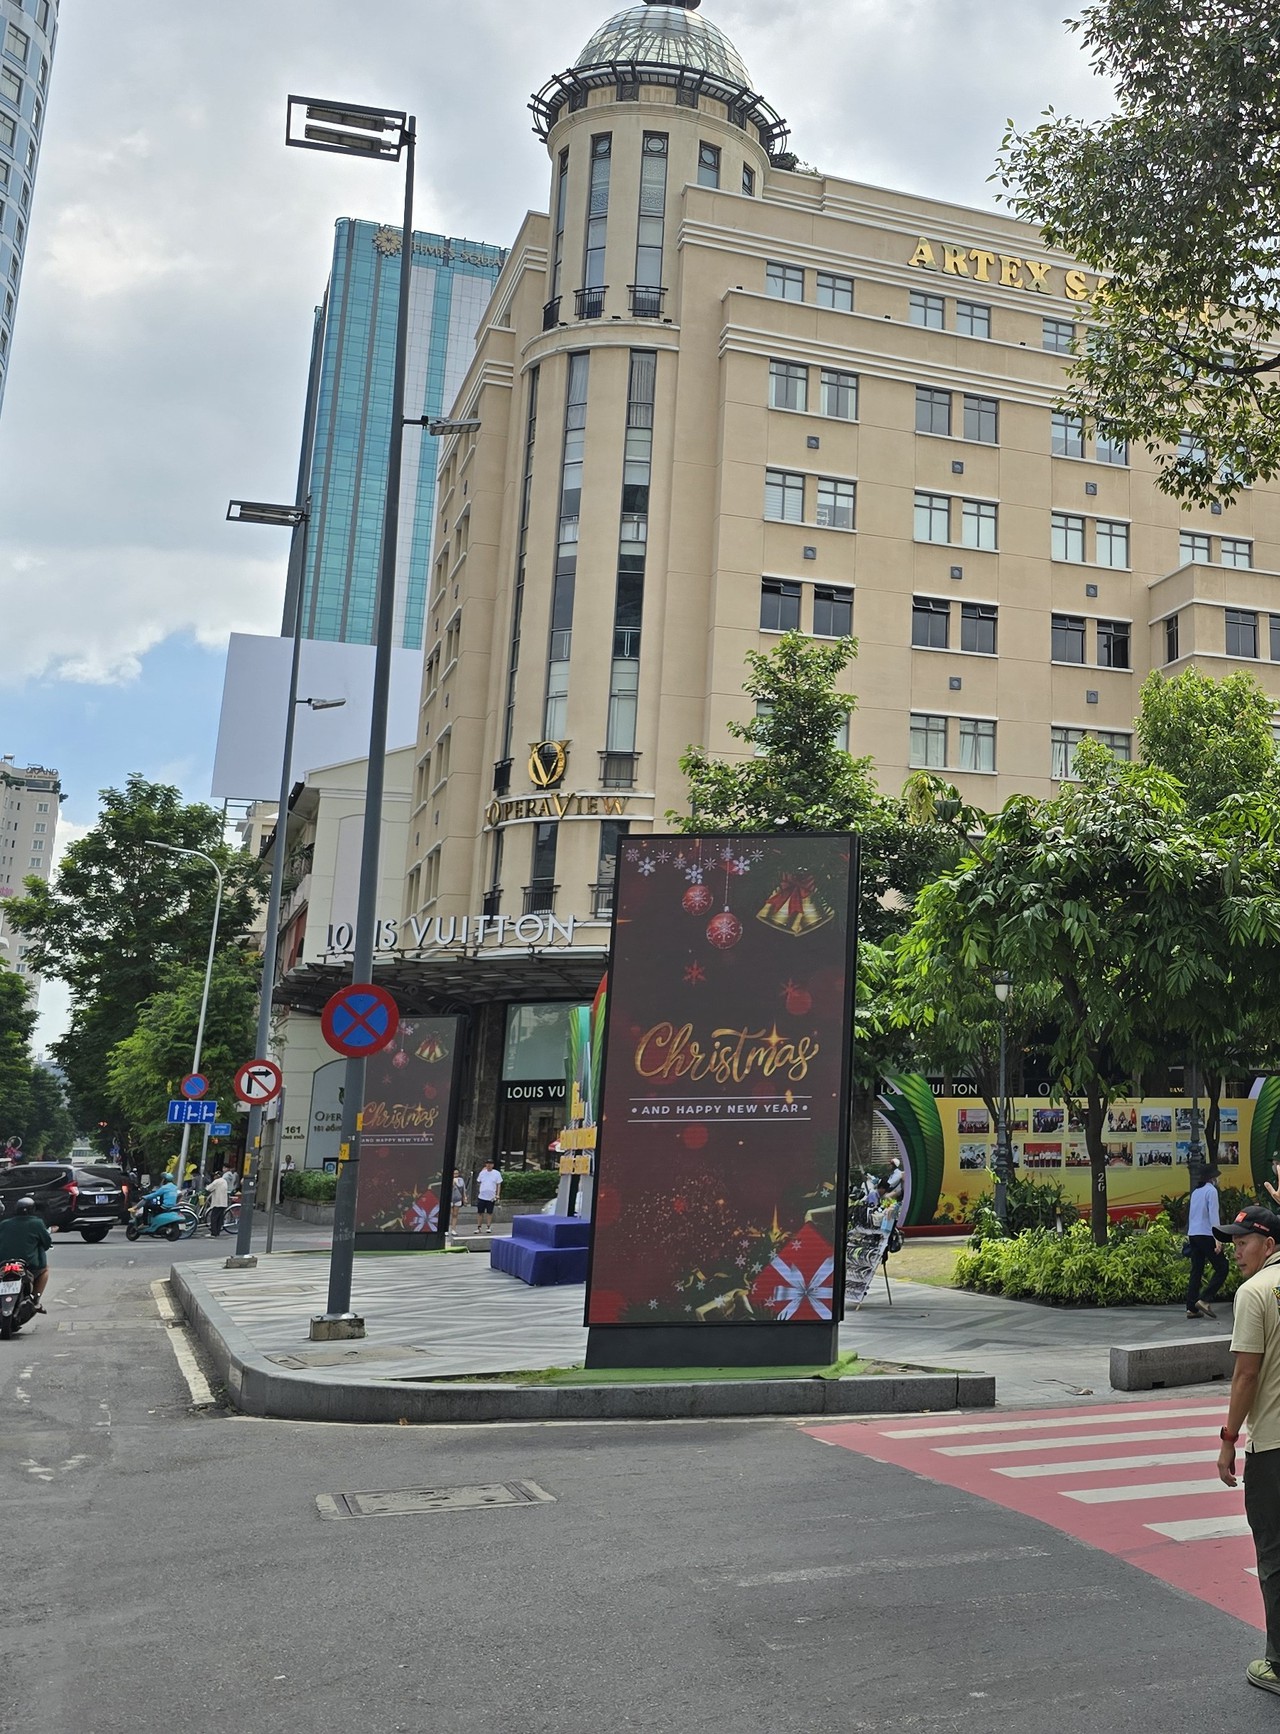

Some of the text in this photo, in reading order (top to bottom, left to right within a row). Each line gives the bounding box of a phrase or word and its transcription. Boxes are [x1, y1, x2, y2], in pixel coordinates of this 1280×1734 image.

[907, 237, 1052, 295] ARTEX
[327, 913, 576, 951] LOIS VUITTON
[634, 1021, 819, 1084] Christmas
[507, 1086, 544, 1098] LOUIS
[641, 1103, 799, 1115] AND HAPPY NEW YEAR
[285, 1126, 301, 1134] 161
[1097, 1172, 1105, 1182] 2
